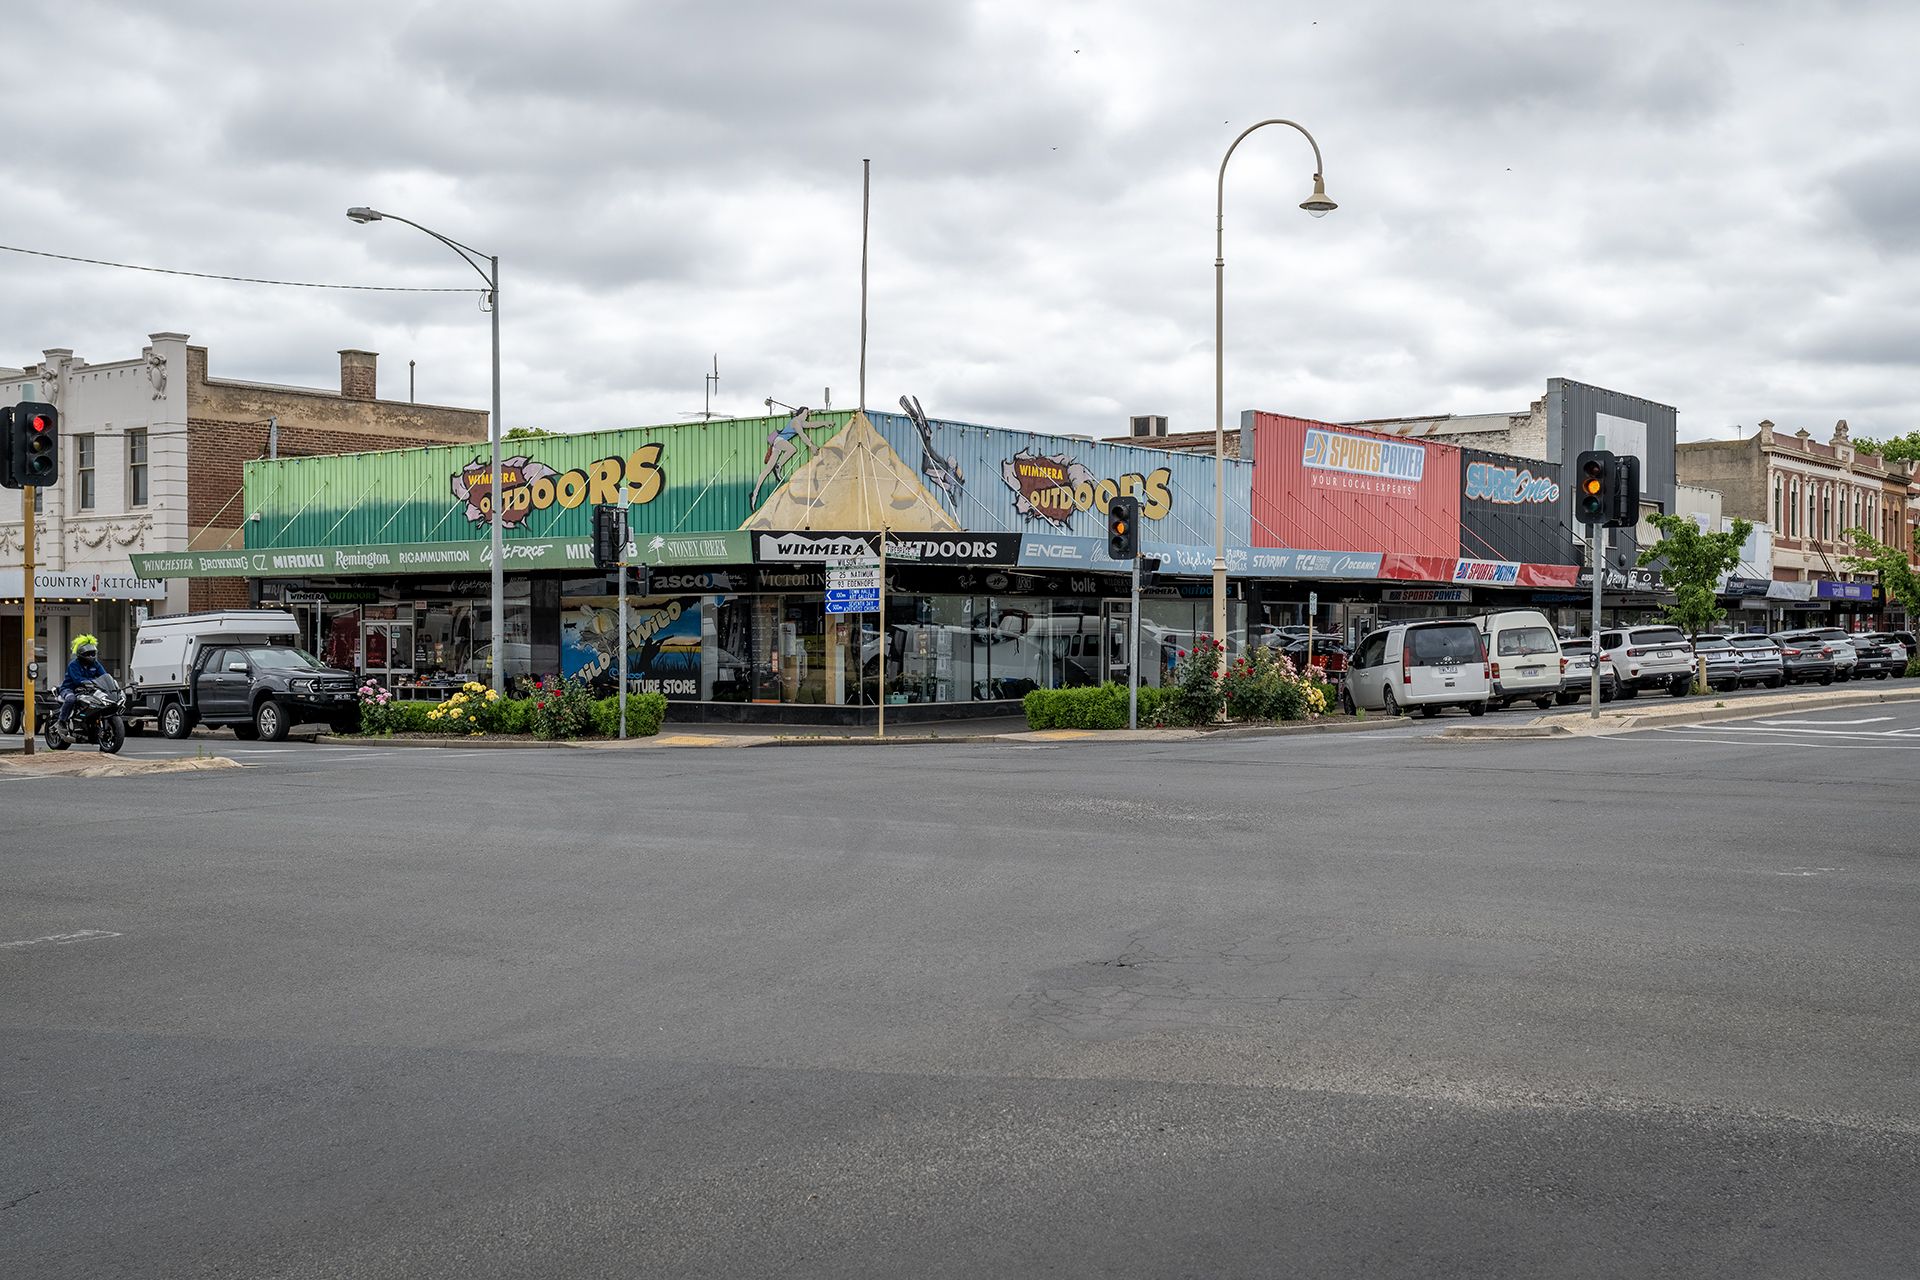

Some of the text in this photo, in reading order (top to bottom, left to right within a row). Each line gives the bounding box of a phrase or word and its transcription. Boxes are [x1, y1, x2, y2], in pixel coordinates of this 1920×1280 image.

[1330, 435, 1424, 479] SPORTSPOWER
[467, 472, 517, 486] WIMRA
[480, 444, 666, 514] OTDOORS
[1019, 464, 1064, 480] WIMMERA
[1312, 474, 1412, 496] YOUR LOCAL EXPERTS
[480, 544, 554, 568] LitFORCE
[565, 542, 638, 560] MINB
[668, 539, 728, 558] STONEY CREEK
[777, 543, 866, 556] WIMMERA
[1025, 543, 1082, 559] ENGEL
[142, 558, 193, 571] WINCHESTER
[199, 556, 248, 571] BROWNING
[273, 554, 324, 570] MIROKU
[334, 550, 391, 570] Remington
[1176, 550, 1216, 571] Ridgelin
[1348, 560, 1377, 571] OCEANIC
[760, 569, 826, 587] VICTORIN
[839, 571, 847, 579] 25
[1467, 563, 1518, 583] SPORTSPOWER
[34, 575, 156, 590] COUNTRY KITCHEN
[654, 574, 708, 589] asco
[290, 591, 377, 601] WIMMERA OUTDOORS
[1181, 585, 1233, 596] OUTDOS
[1402, 589, 1462, 601] SPORTSPOWER
[662, 679, 697, 695] STORE
